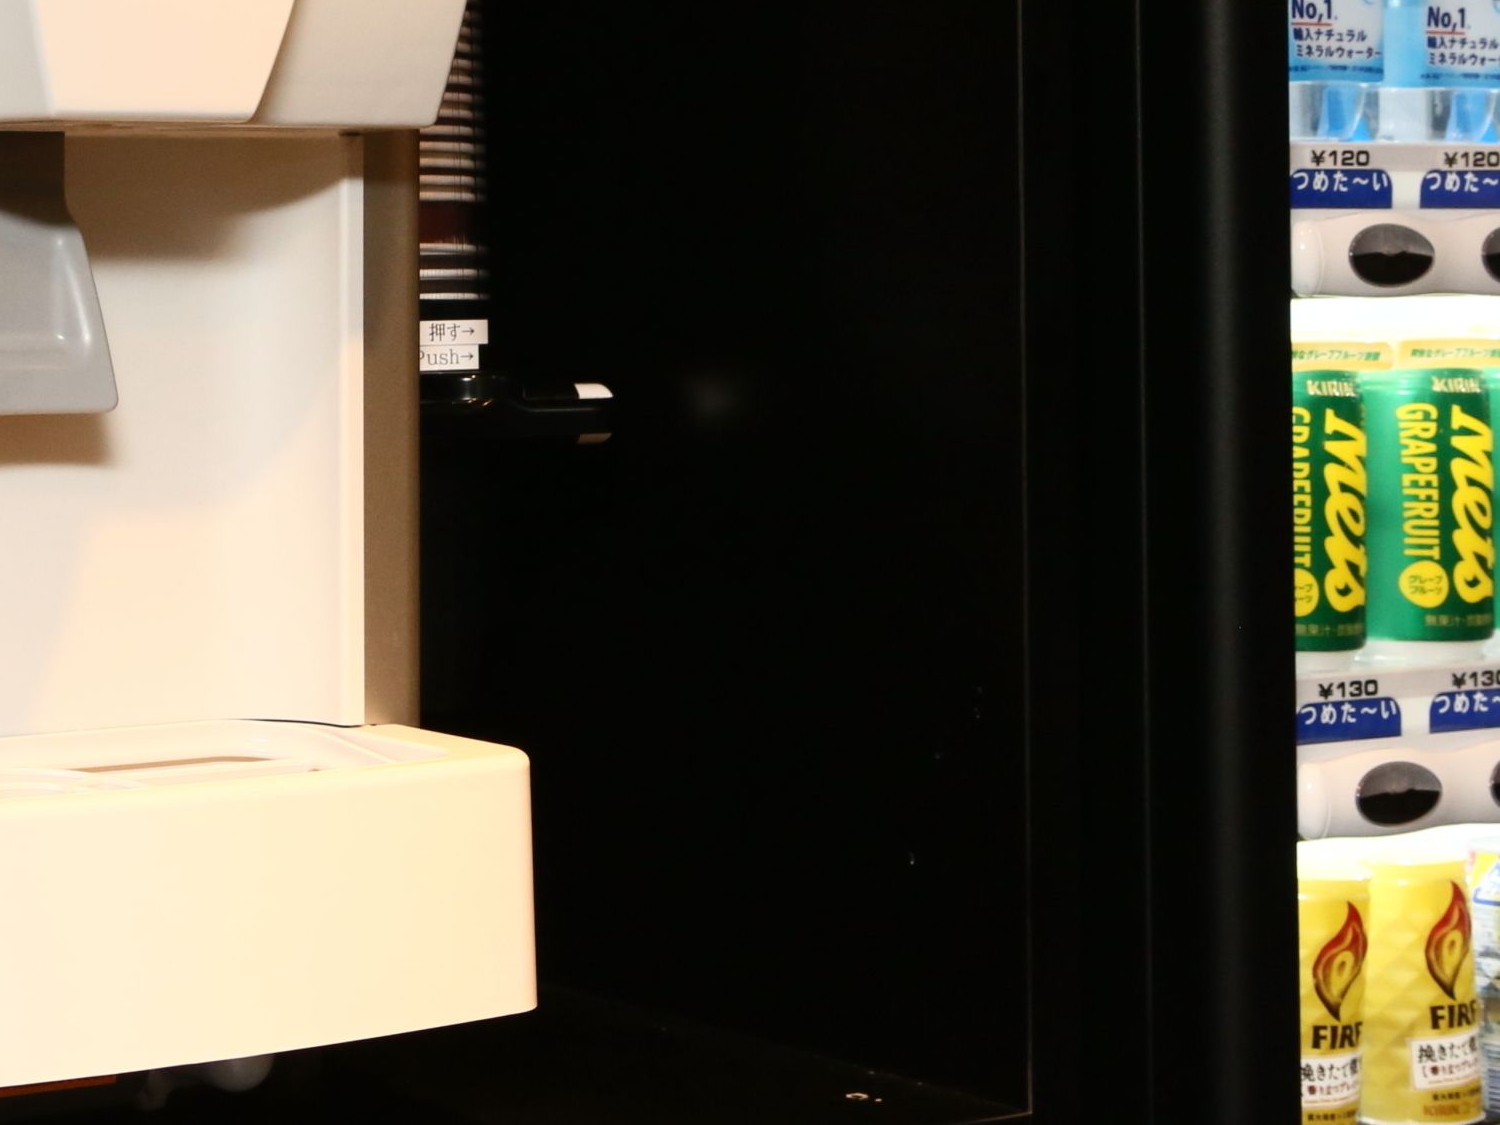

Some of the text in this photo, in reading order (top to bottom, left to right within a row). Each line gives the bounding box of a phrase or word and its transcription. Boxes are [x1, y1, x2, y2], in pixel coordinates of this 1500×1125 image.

[1311, 150, 1370, 166] ¥120
[1444, 151, 1500, 167] ¥120
[429, 322, 460, 342] 押す
[1306, 379, 1356, 397] KIRIN
[1432, 376, 1481, 393] KIRIN
[1396, 402, 1441, 560] GRAPEFRUIT
[1318, 679, 1378, 700] ¥130
